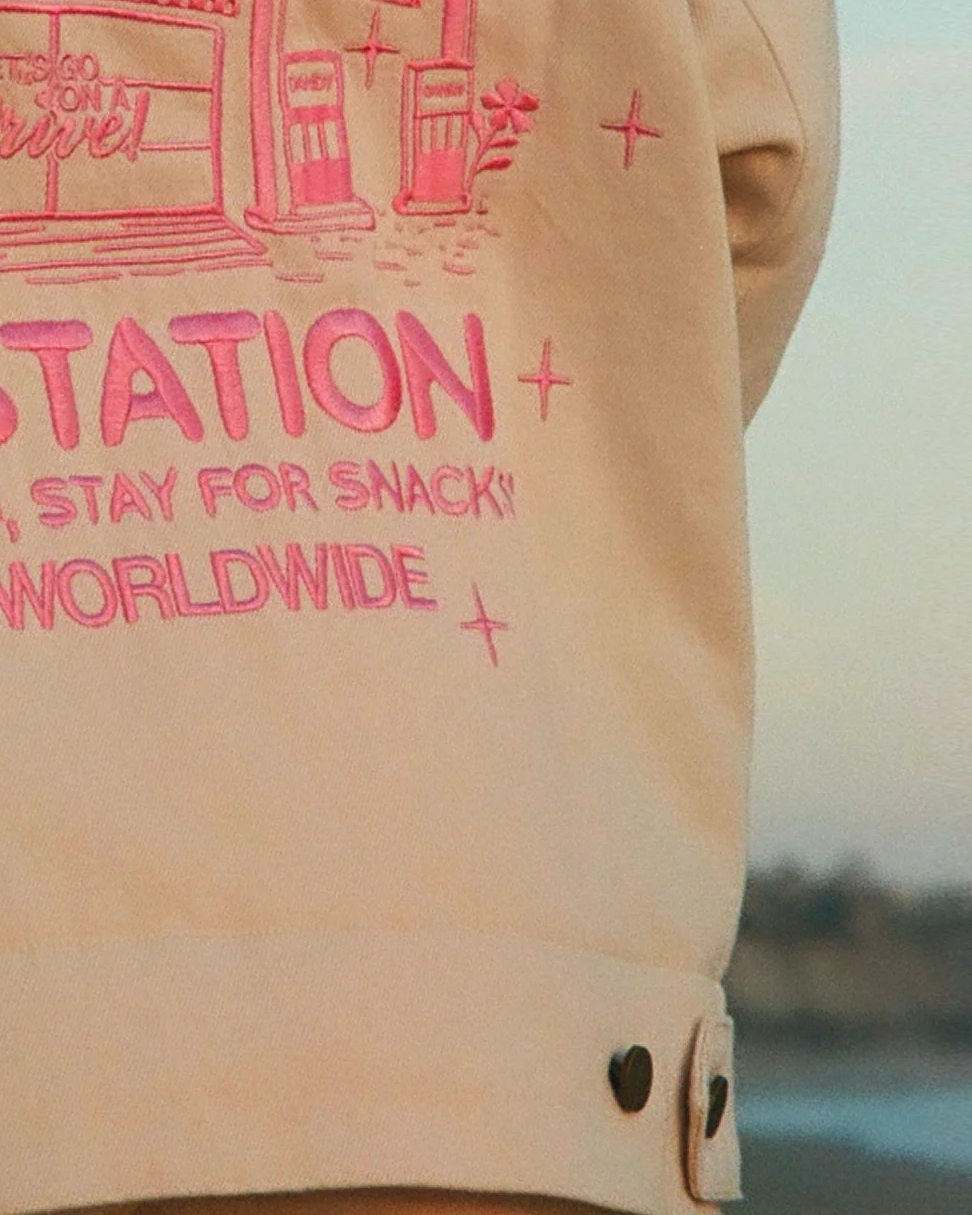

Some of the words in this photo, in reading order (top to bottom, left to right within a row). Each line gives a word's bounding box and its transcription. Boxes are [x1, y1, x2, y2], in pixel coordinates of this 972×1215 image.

[59, 51, 101, 82] GO
[58, 85, 102, 113] ON
[111, 78, 132, 113] A
[30, 465, 178, 529] STAY
[197, 462, 318, 518] FOR
